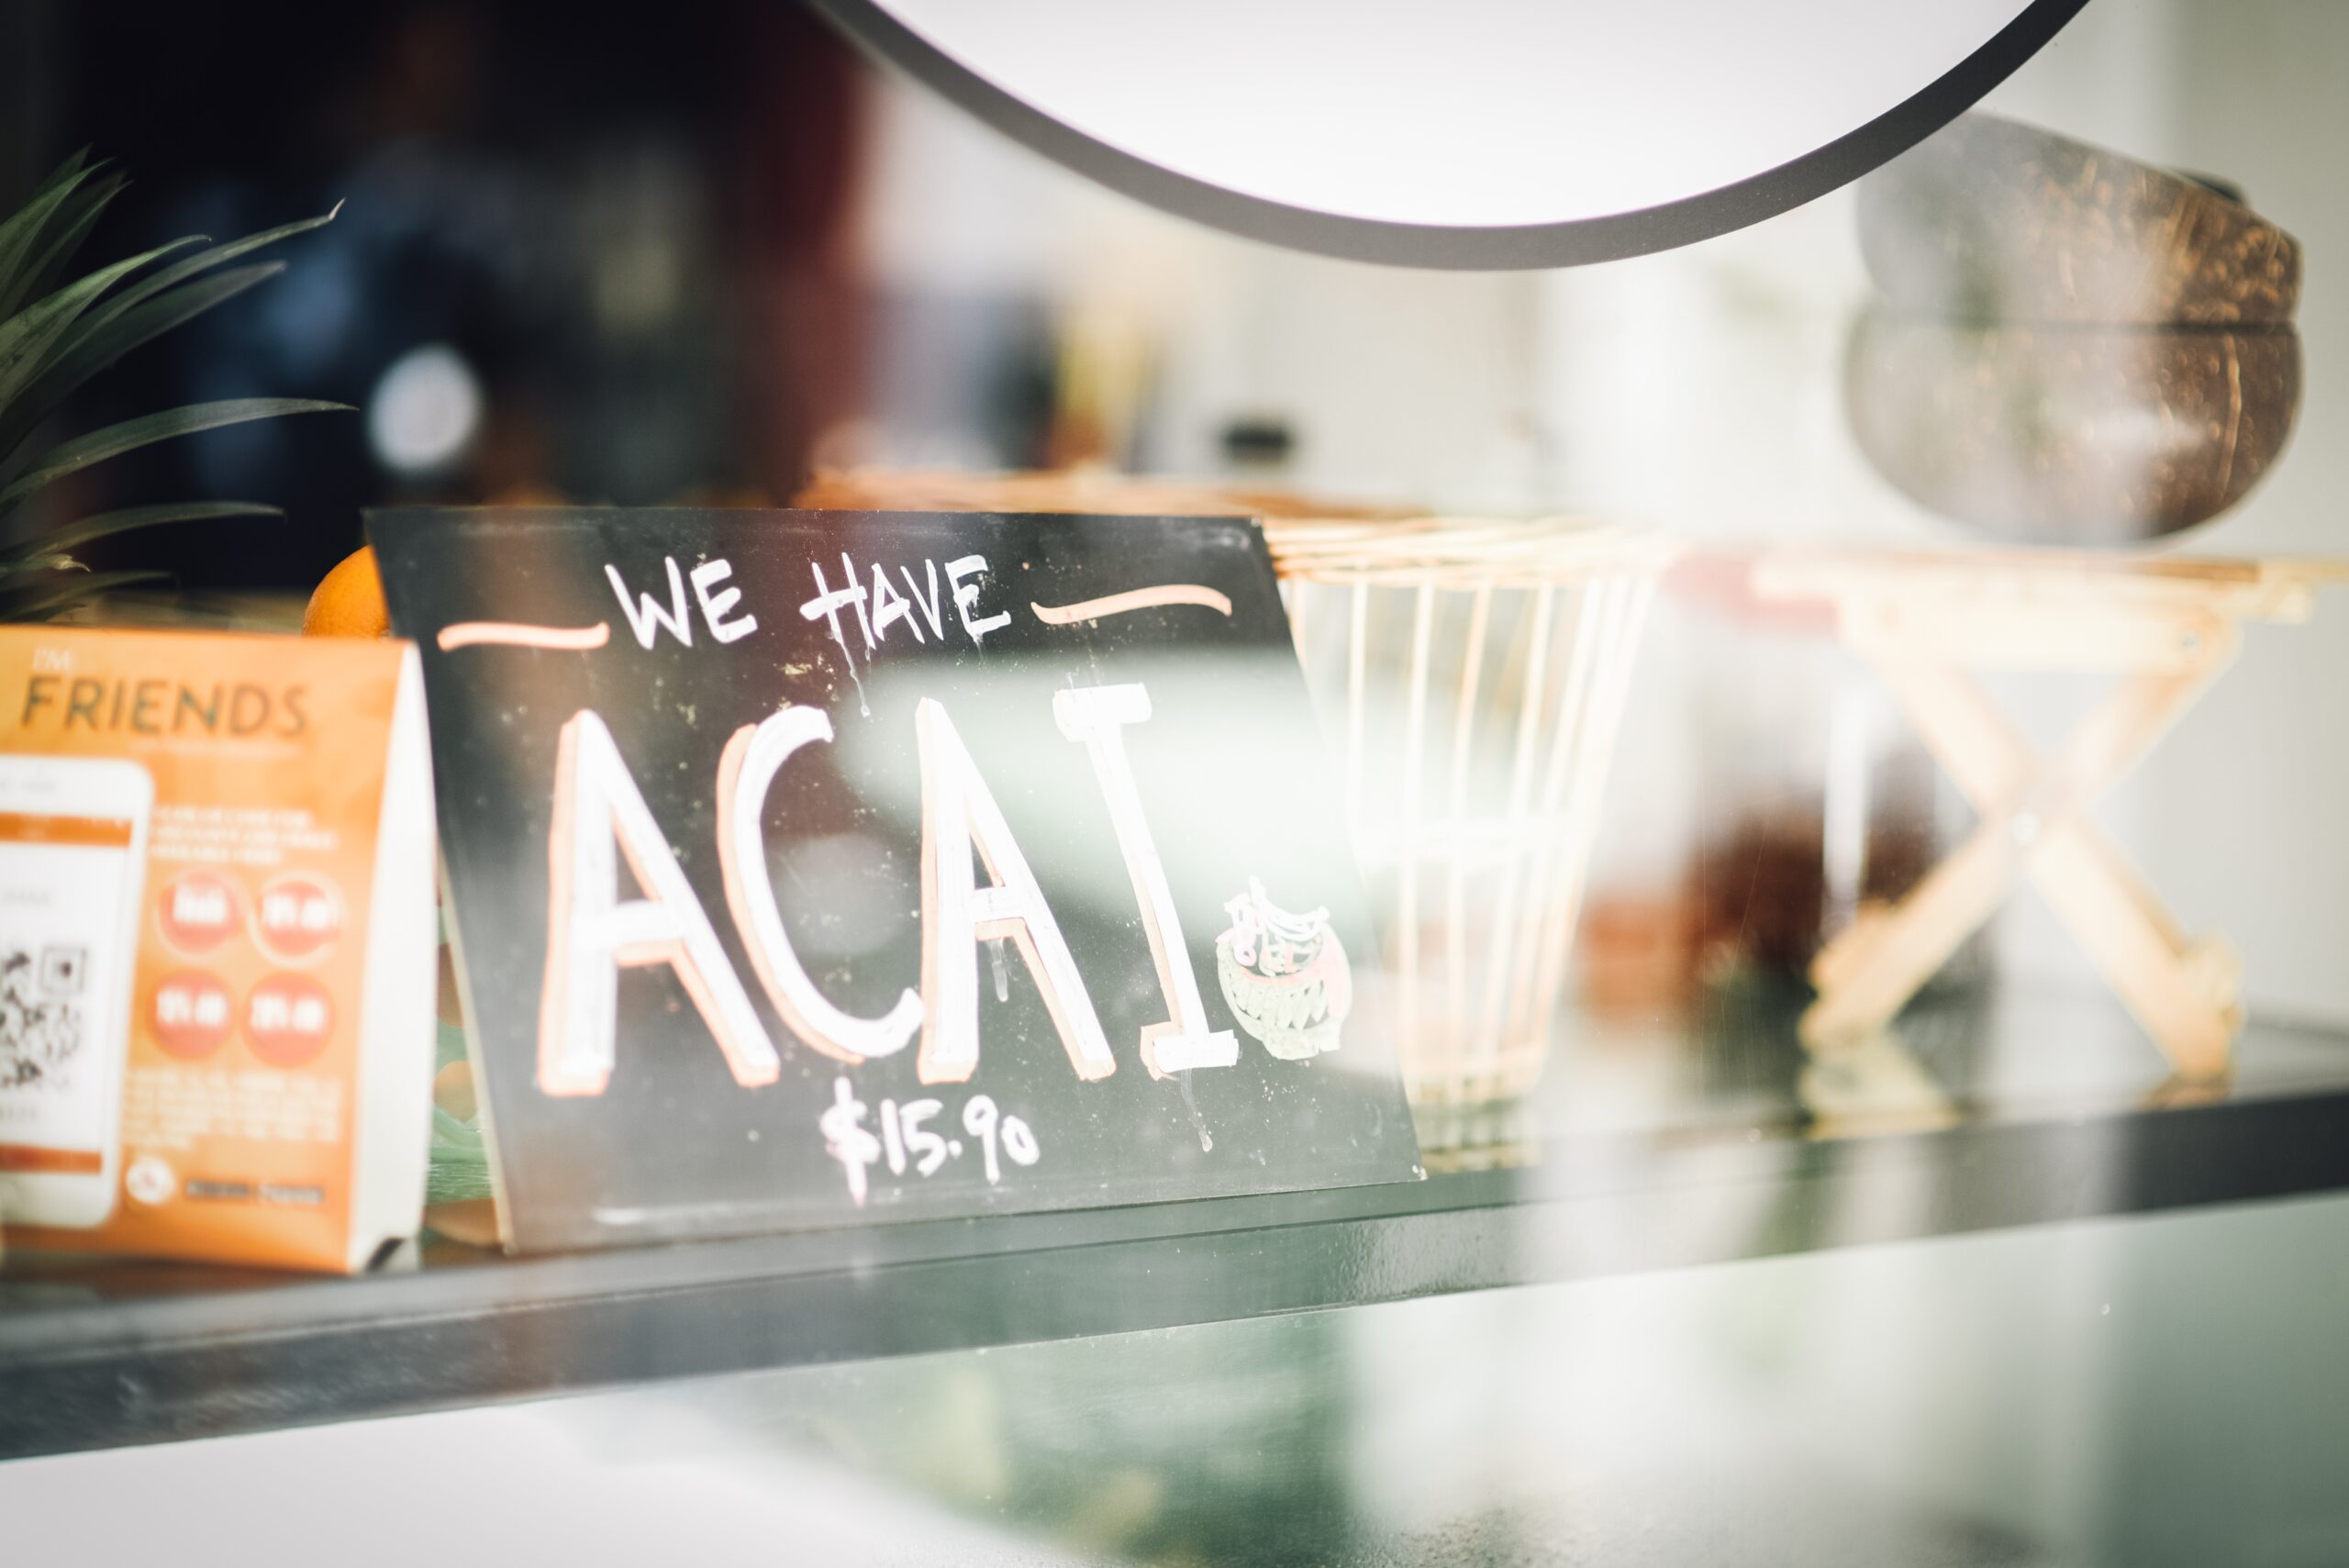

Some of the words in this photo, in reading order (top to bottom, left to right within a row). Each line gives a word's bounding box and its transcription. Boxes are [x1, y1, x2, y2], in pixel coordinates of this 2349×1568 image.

[605, 556, 757, 651] WE
[799, 552, 1010, 650] HAVE
[21, 675, 308, 736] FRIENDS
[537, 683, 1241, 1096] ACAI
[819, 1076, 1040, 1207] $15.90
